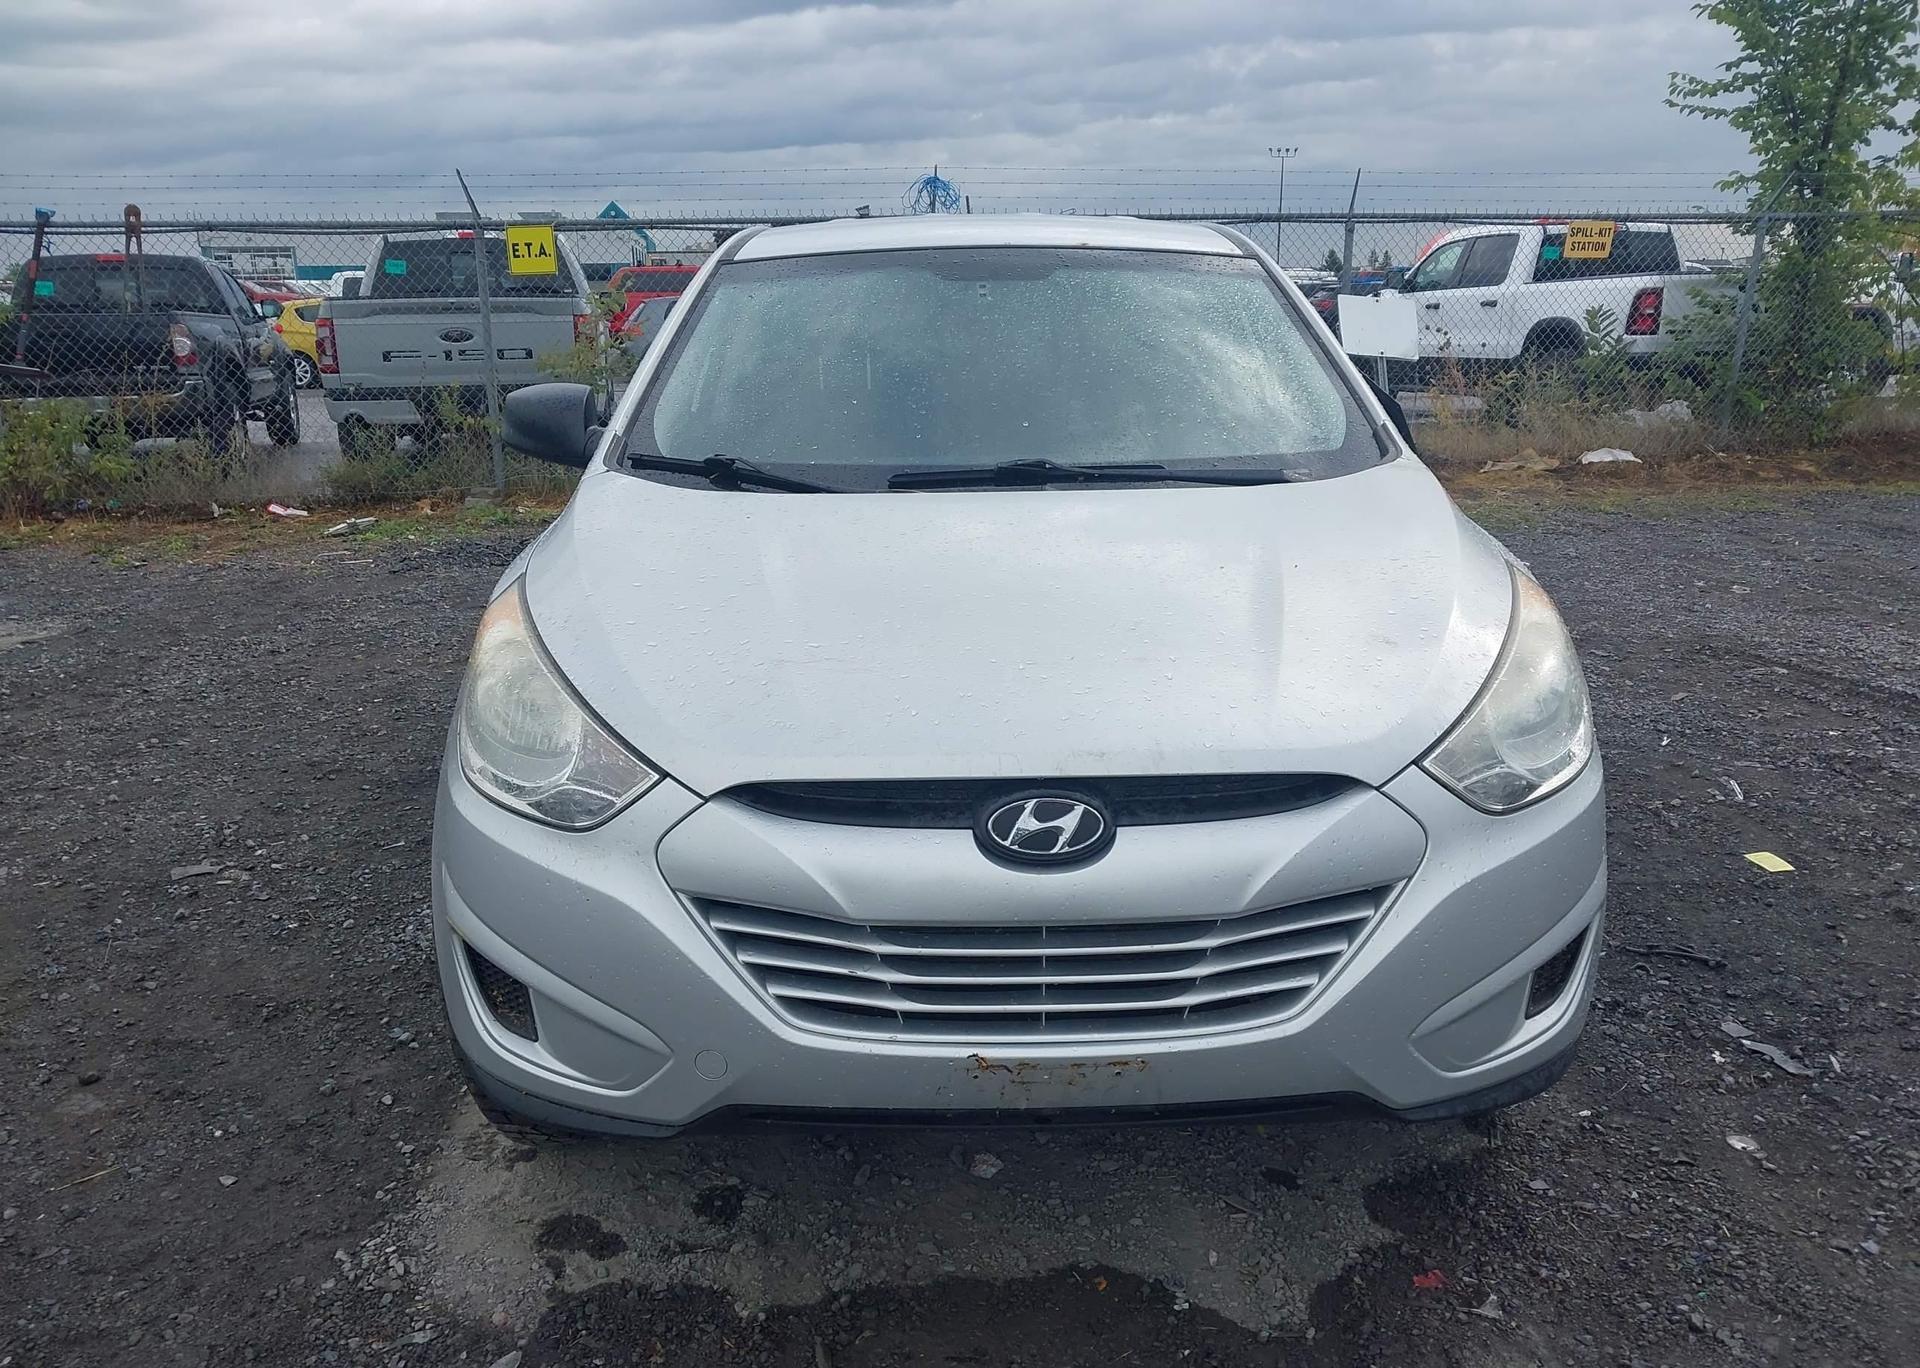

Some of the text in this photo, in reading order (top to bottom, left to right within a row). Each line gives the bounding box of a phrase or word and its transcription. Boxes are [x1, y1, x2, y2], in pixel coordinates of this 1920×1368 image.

[1570, 227, 1612, 238] SPILL-KIT
[512, 241, 551, 258] E.T.A.
[1570, 241, 1606, 252] STATION
[382, 348, 533, 362] F-150
